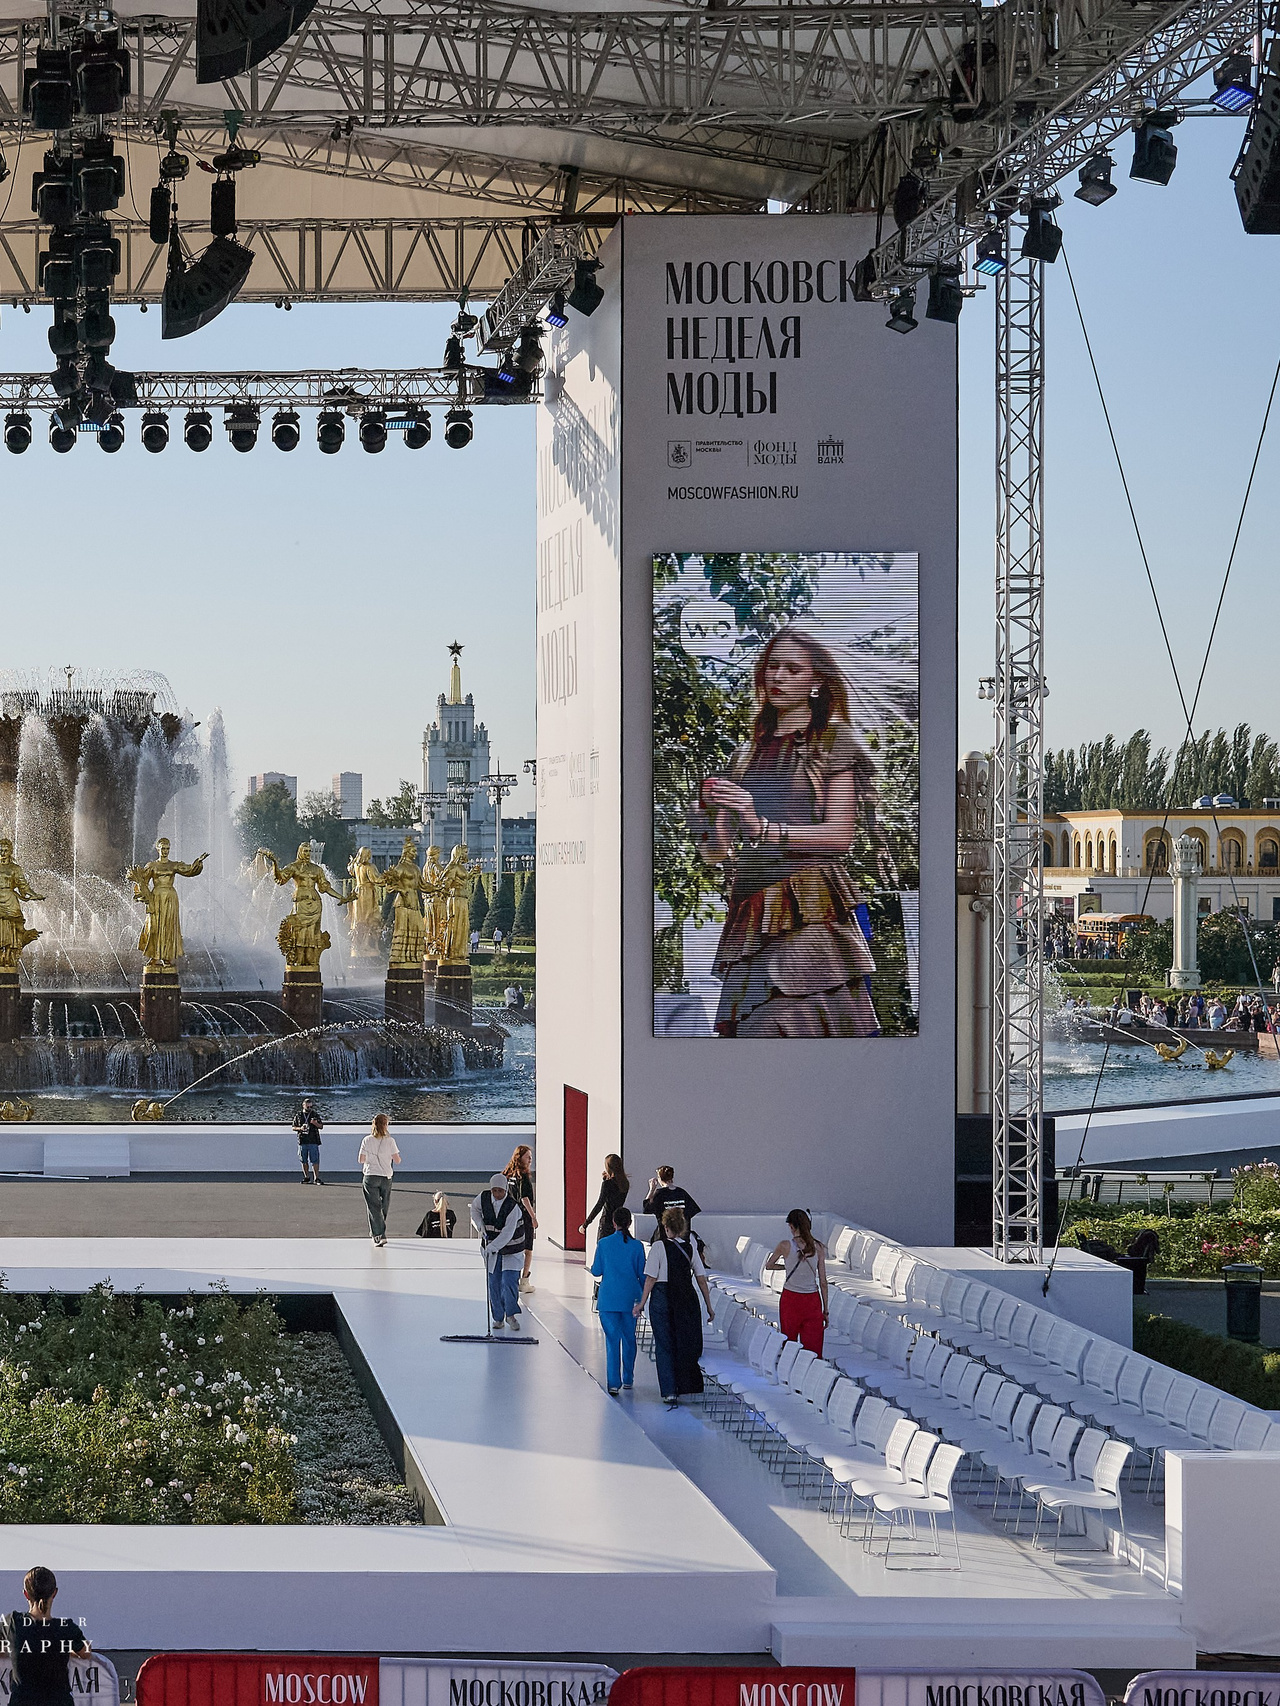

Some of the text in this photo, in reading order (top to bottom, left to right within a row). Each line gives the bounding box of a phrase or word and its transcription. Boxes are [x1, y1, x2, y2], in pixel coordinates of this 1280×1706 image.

[666, 260, 860, 304] МОСКОВСК
[667, 316, 801, 363] НЕДЕЛЯ
[667, 371, 777, 418] МОДЫ
[753, 440, 797, 454] ФОНД
[753, 454, 797, 466] МОДЫ
[817, 456, 844, 464] ВДНХ
[667, 486, 799, 500] MOSCOWFASHION.RU
[540, 517, 584, 613] НЕДЕЛЯ
[540, 620, 579, 708] МОДЫ
[265, 1673, 368, 1704] MOSCOW
[449, 1678, 607, 1706] МОСКОВСКАЯ
[739, 1683, 844, 1706] MOSCOW
[926, 1683, 1085, 1706] МОСКОВСКАЯ
[1144, 1688, 1280, 1706] МОСКОВСК
